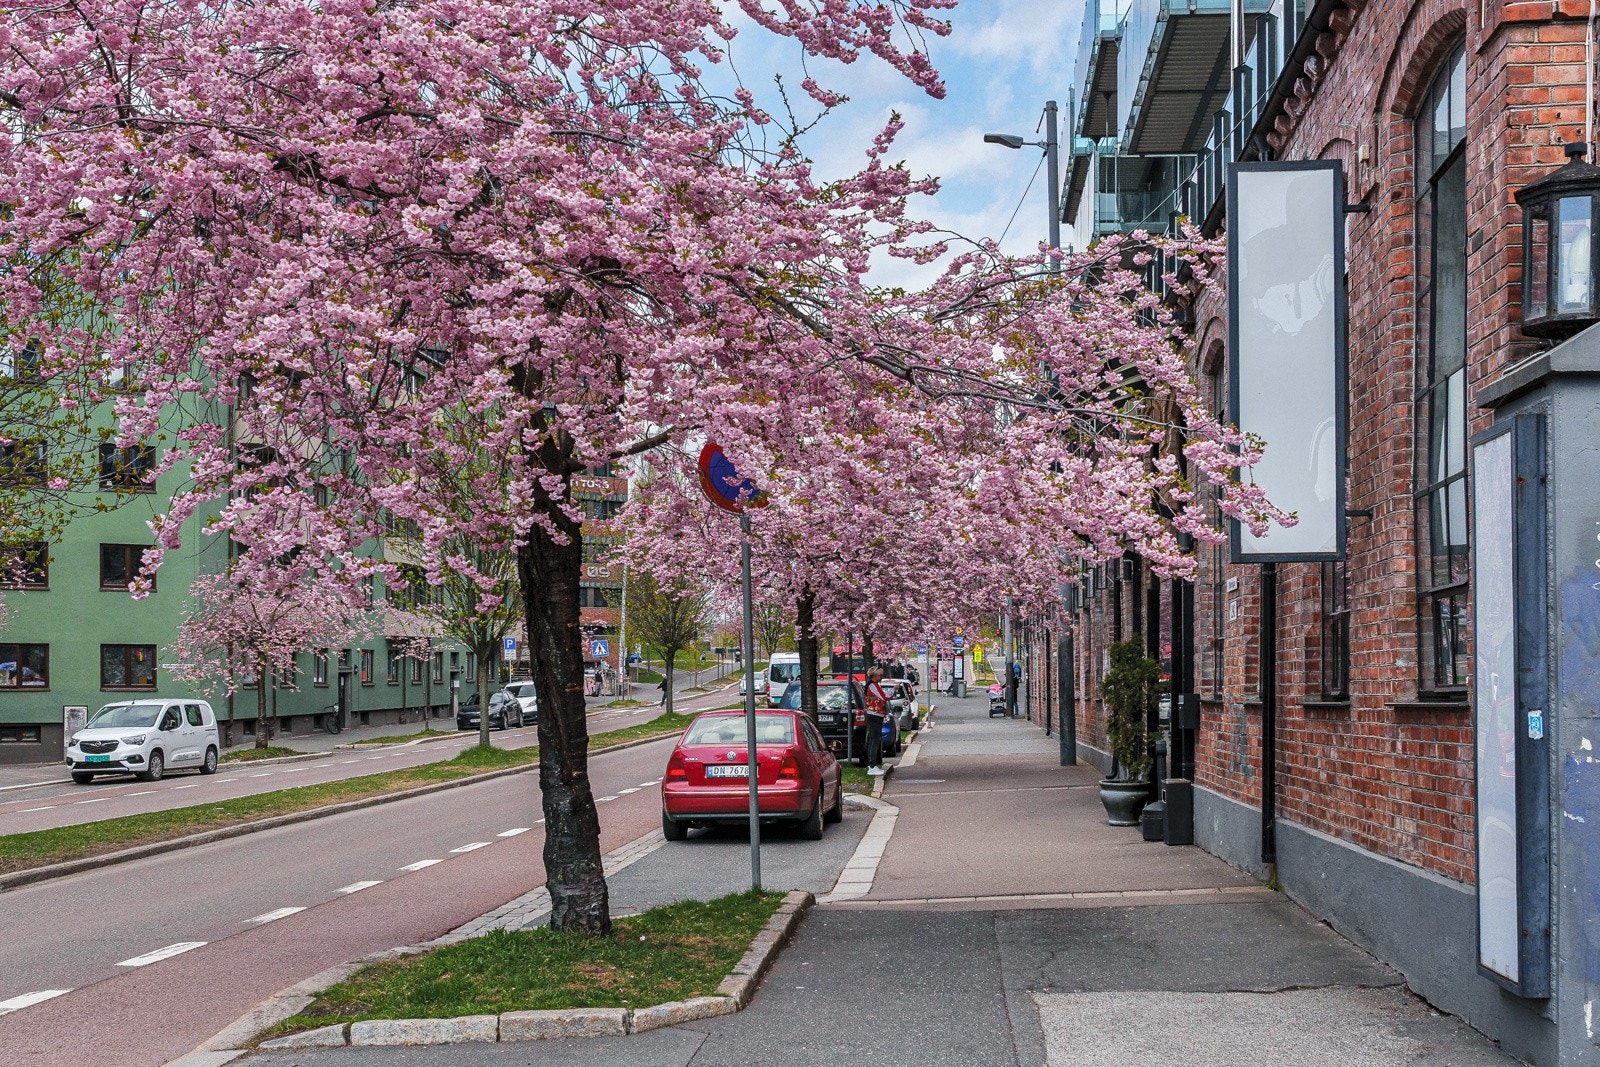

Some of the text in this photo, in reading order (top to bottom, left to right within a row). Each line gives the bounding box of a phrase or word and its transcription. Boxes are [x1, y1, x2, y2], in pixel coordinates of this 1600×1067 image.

[506, 639, 514, 649] P
[713, 766, 750, 775] DN 7678
